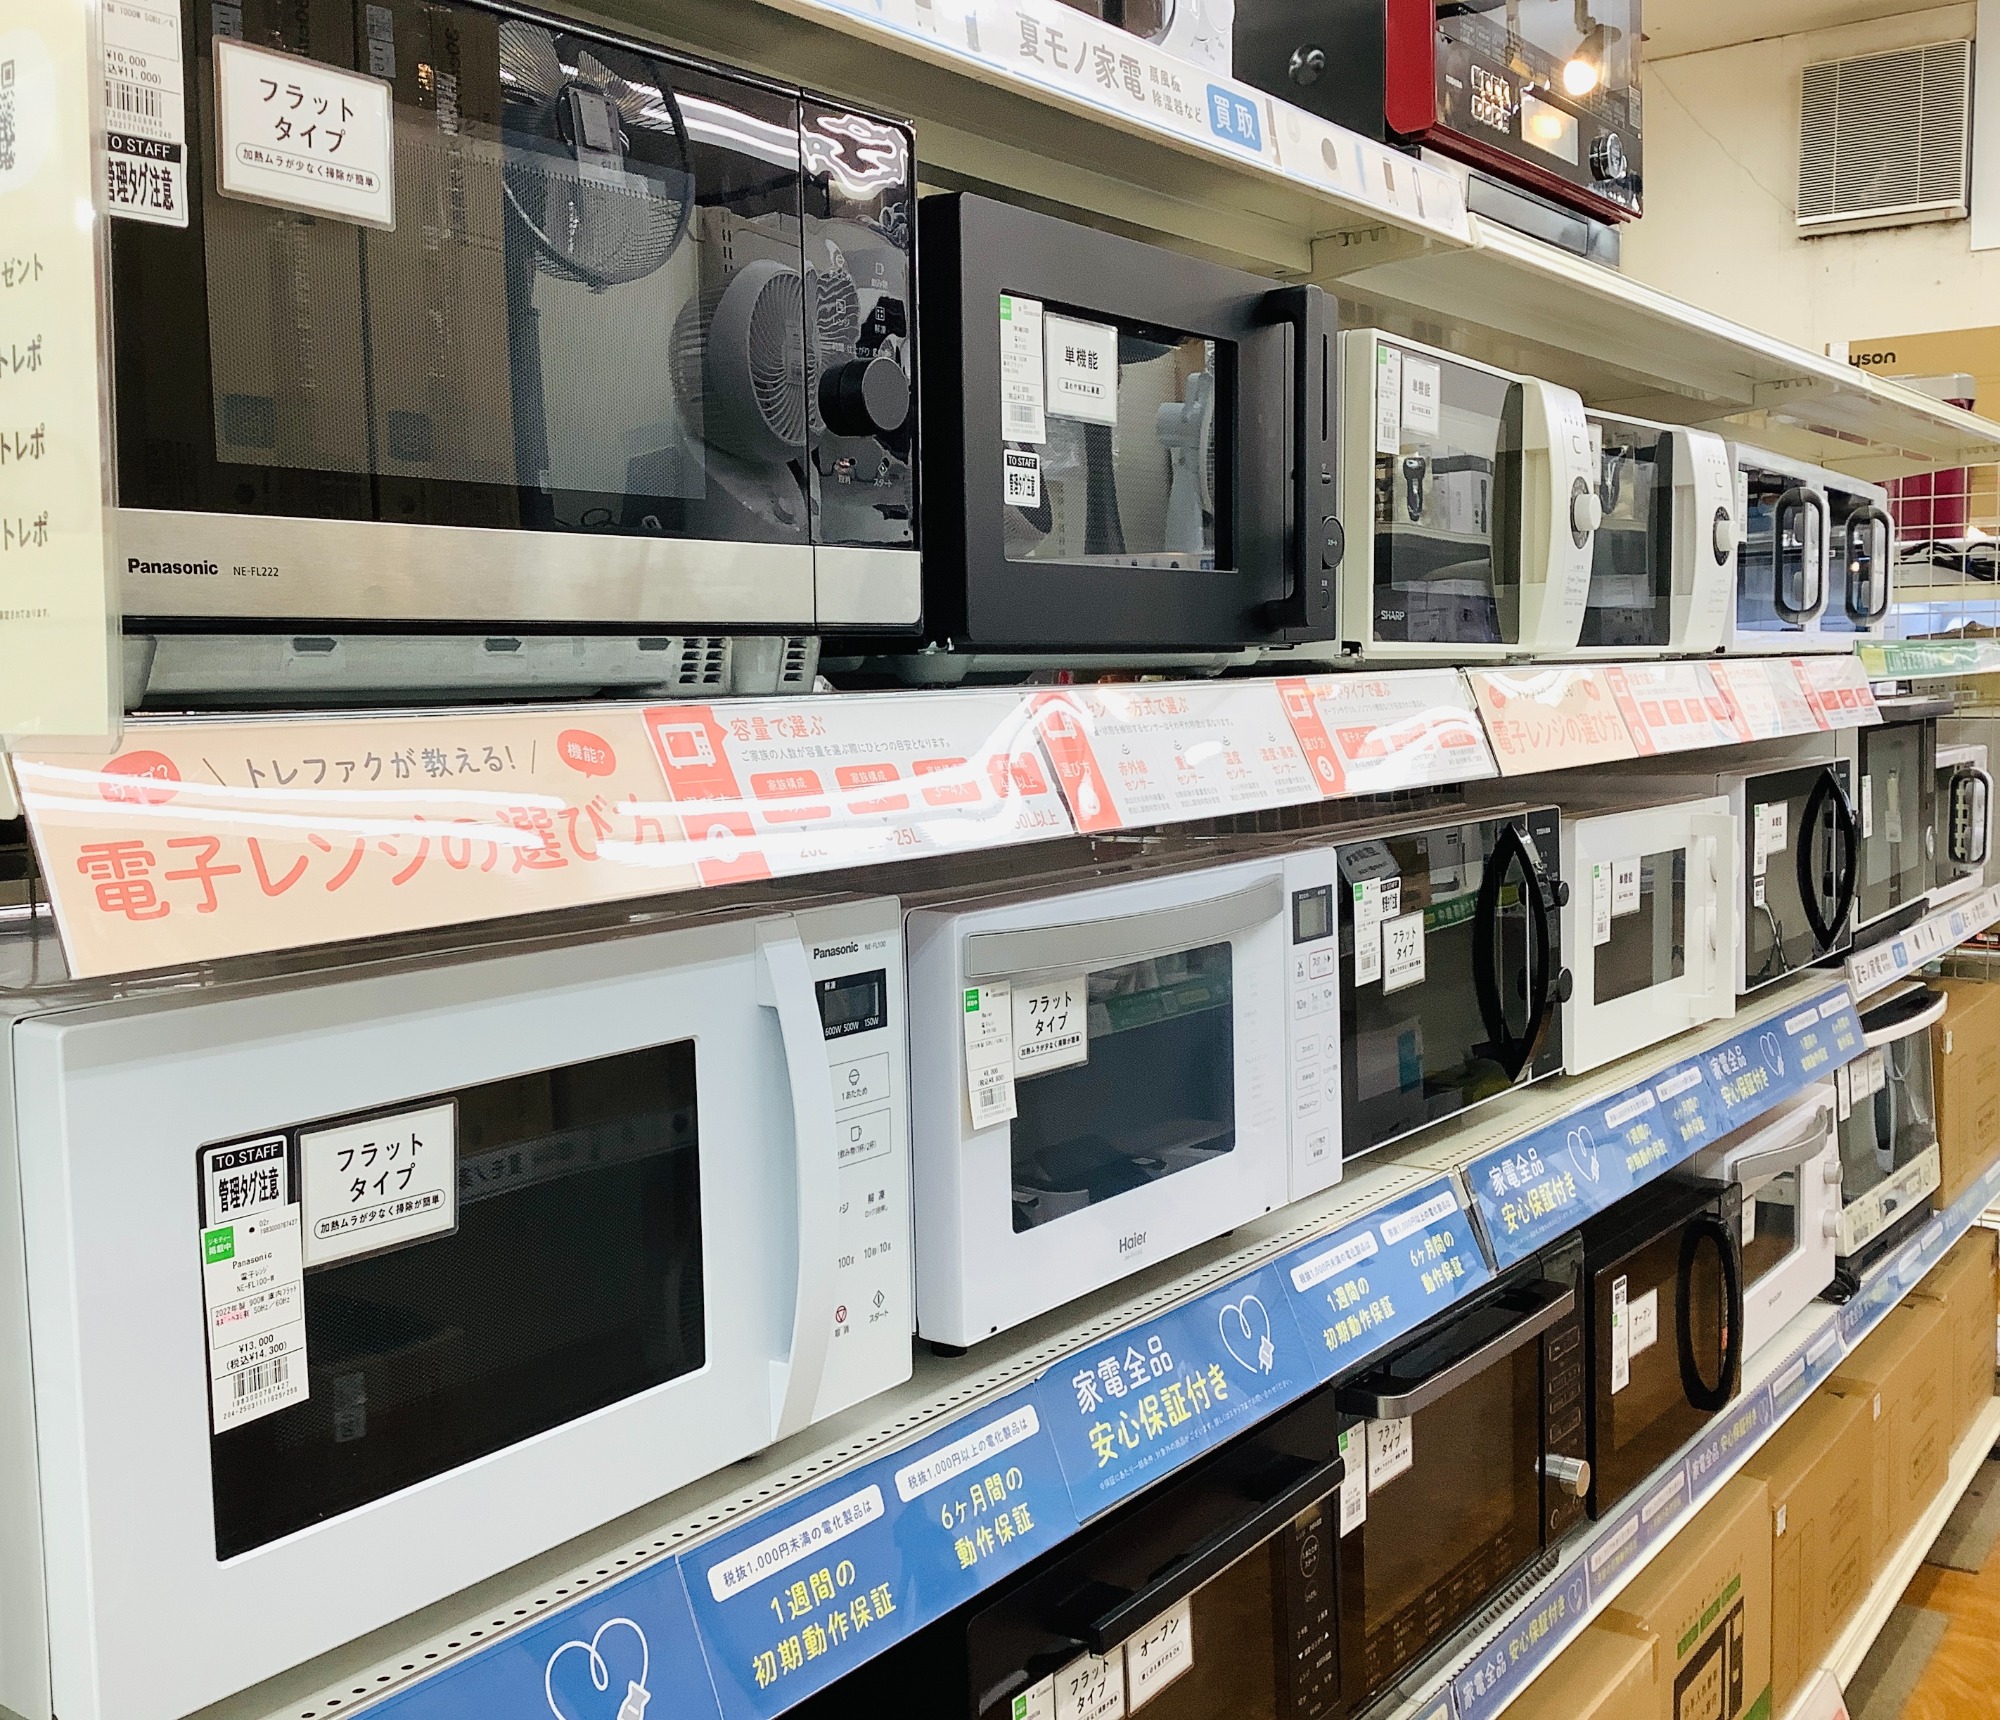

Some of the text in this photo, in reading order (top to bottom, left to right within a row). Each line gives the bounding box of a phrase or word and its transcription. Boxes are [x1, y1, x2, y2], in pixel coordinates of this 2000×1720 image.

[1016, 11, 1145, 102] 夏モノ家電
[259, 78, 355, 122] フラット
[1213, 96, 1256, 141] 買取
[107, 133, 172, 158] O STAFF
[274, 116, 347, 153] タイプ
[107, 157, 175, 211] 管理タグ注意
[242, 147, 375, 188] 加熱ムラが少なく掃除が簡単
[1064, 346, 1099, 370] 単機能
[1848, 351, 1897, 368] yson
[0, 422, 46, 464] トレポ
[1018, 456, 1036, 468] STAFF
[3, 511, 49, 551] トレポ
[127, 557, 280, 578] Panasonic NE-FL222
[1380, 609, 1405, 621] SHARP
[730, 715, 826, 742] 容量で選ぶ
[1492, 711, 1623, 755] 電子レンジの選び方
[246, 744, 517, 788] トレファクが教える!
[567, 741, 606, 765] 機能?
[813, 941, 859, 960] Panasonic
[1393, 926, 1416, 944] フラット
[1029, 991, 1072, 1015] フラット
[843, 1021, 860, 1033] 500W
[864, 1016, 880, 1027] 150W
[1035, 1011, 1068, 1036] タイプ
[1709, 1045, 1748, 1081] 家電全品
[215, 1144, 279, 1169] TO STAFF
[337, 1133, 424, 1173] フラット
[1488, 1147, 1545, 1197] 家電全品
[218, 1167, 280, 1213] 管理タグ注意
[350, 1162, 416, 1203] タイプ
[320, 1195, 440, 1234] 加熱ムラが少なく掃除が簡単
[1501, 1171, 1577, 1235] 安心保証付き
[232, 1252, 273, 1270] Panasonic
[1118, 1231, 1147, 1253] Haier
[1326, 1277, 1370, 1312] 1週間の
[1420, 1256, 1466, 1295] 動作保証
[869, 1309, 889, 1323] スタート
[1322, 1295, 1396, 1352] 初期動作保証
[1072, 1335, 1174, 1415] 家電全品
[1088, 1363, 1229, 1468] 安心保証付き
[907, 1419, 1028, 1490] 税抜1,000円以上の電化製品は
[723, 1500, 873, 1588] 税抜1,000円未満の電化製品は
[954, 1502, 1035, 1570] 動作保証
[769, 1559, 856, 1625] 1週間の
[752, 1582, 897, 1690] 初期動作保証
[1140, 1618, 1179, 1657] オーブン
[1463, 1595, 1566, 1711] 家電全品 安心保証付き
[1070, 1659, 1110, 1696] フラット
[1077, 1677, 1107, 1714] タイプ
